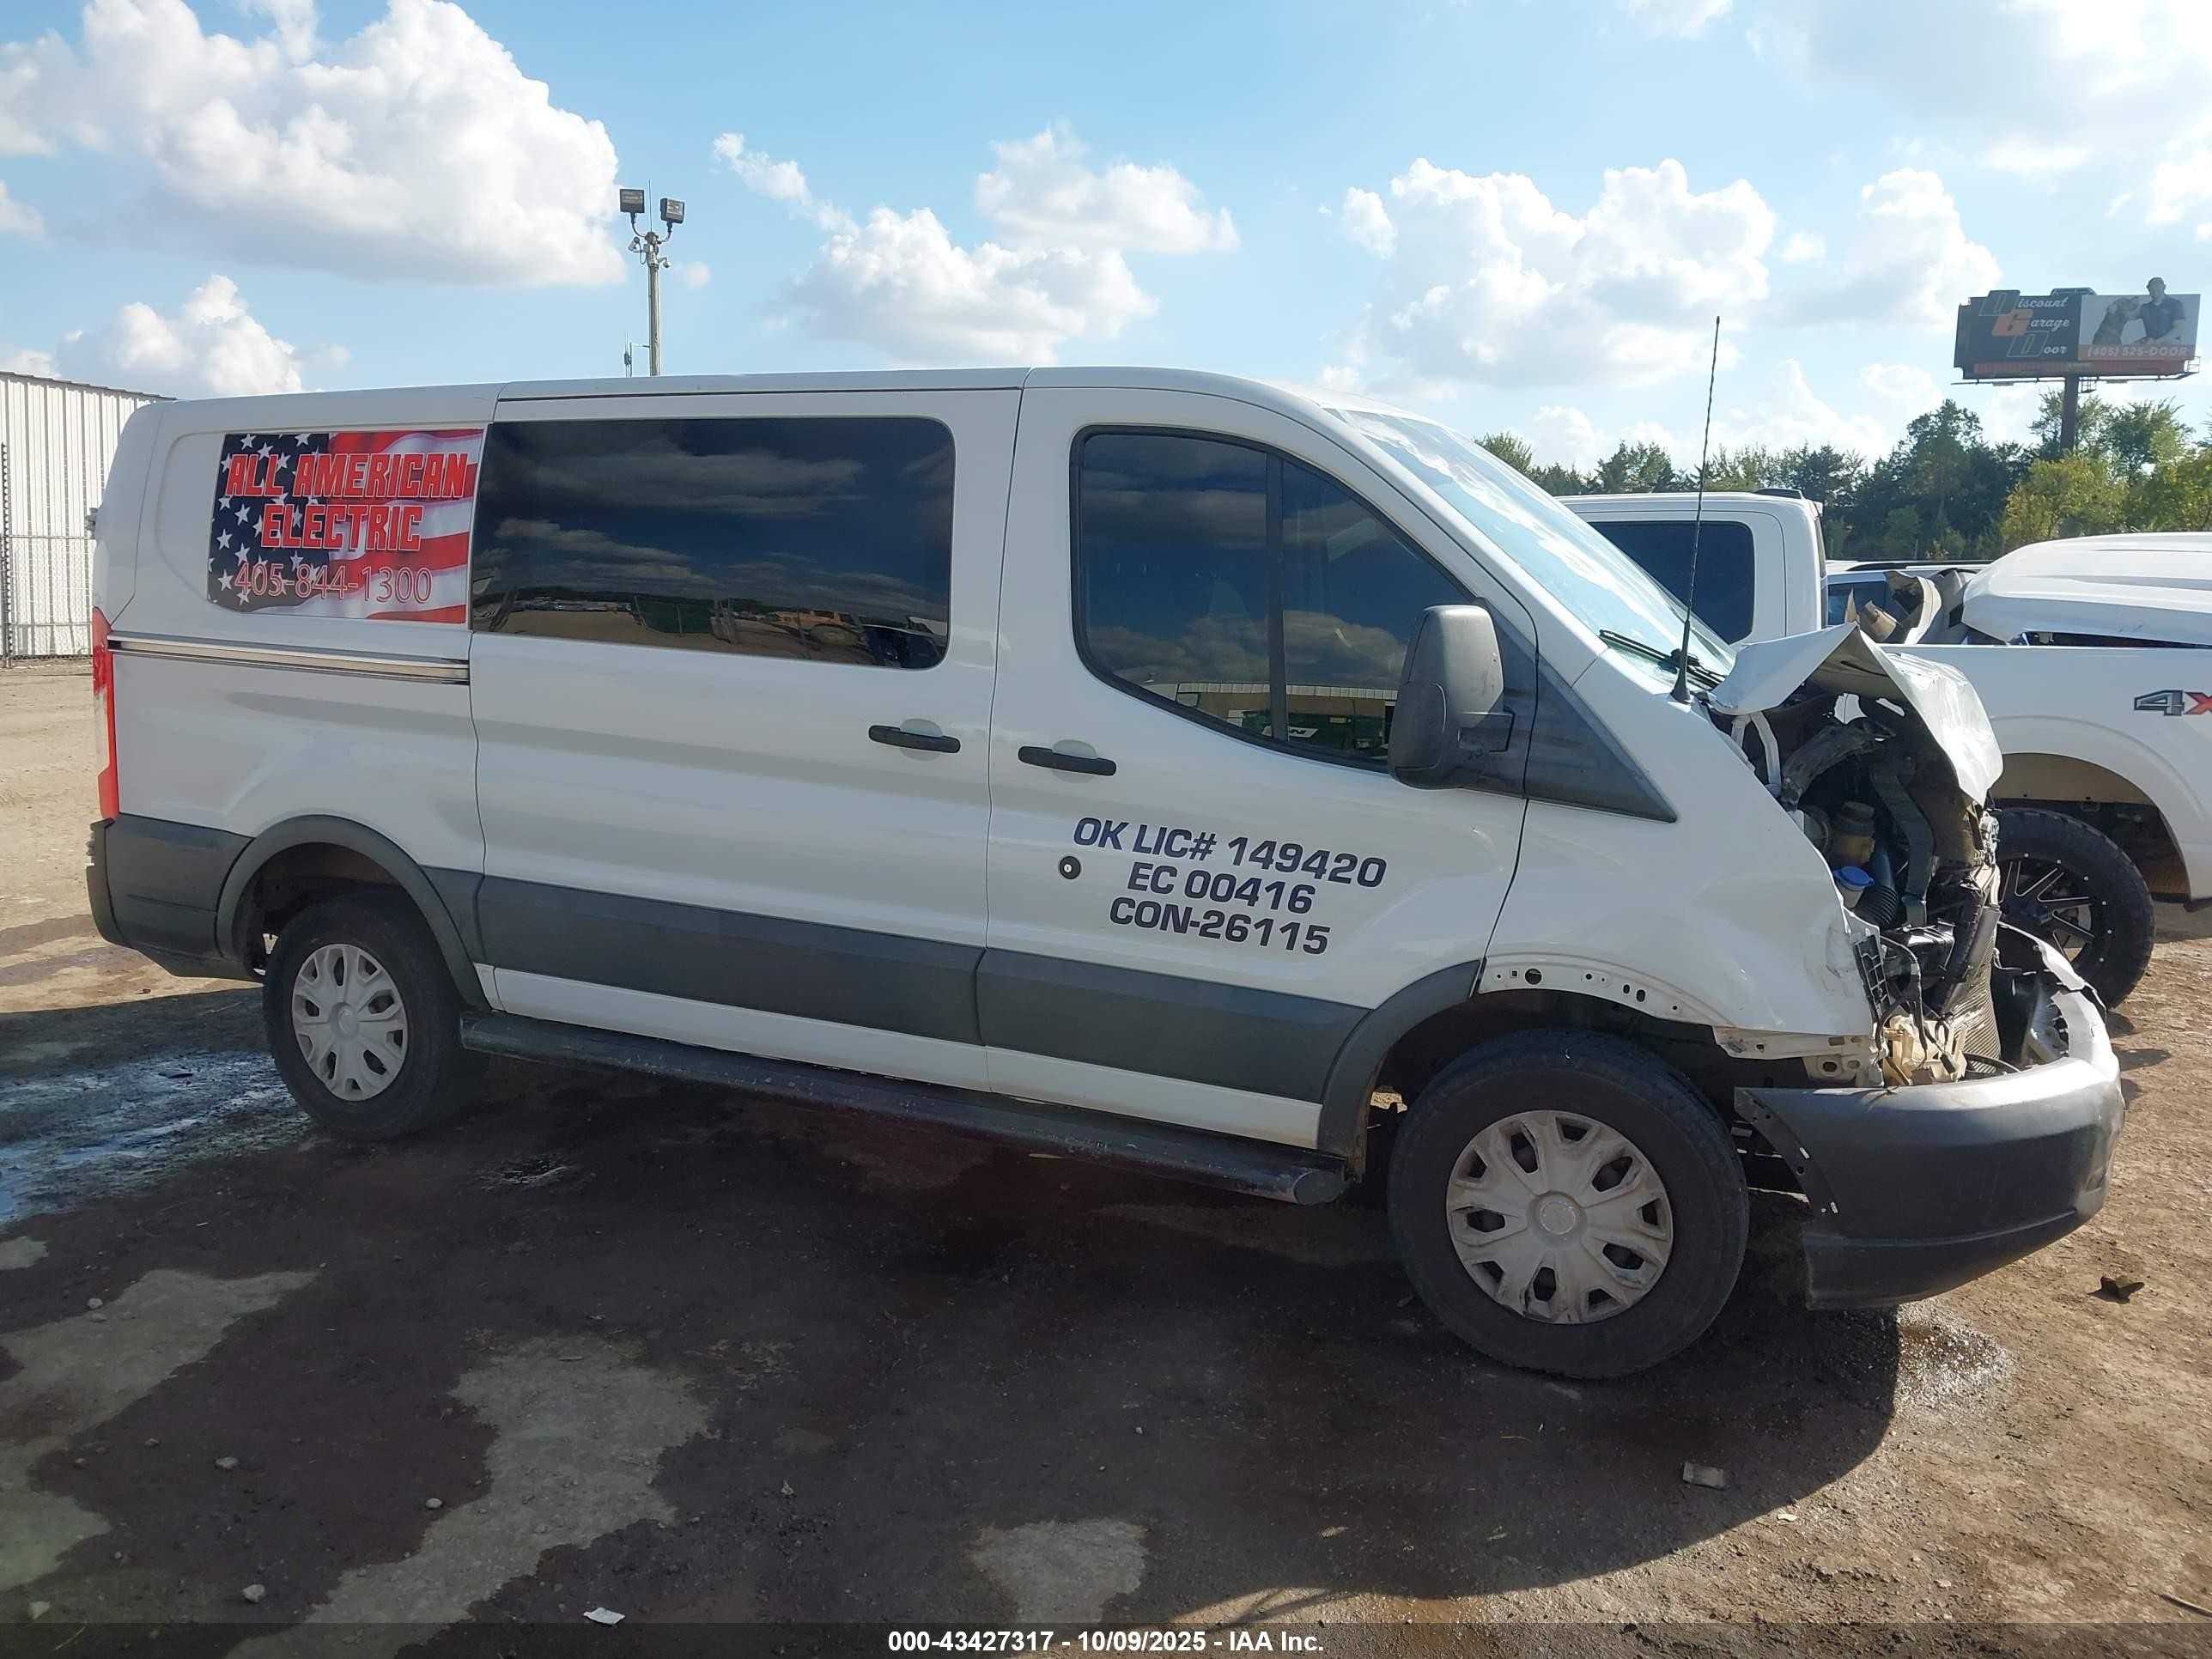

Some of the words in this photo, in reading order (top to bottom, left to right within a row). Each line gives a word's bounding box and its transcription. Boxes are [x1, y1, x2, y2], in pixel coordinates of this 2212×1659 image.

[1978, 290, 2069, 316] Discount
[1991, 308, 2069, 337] Garage
[2006, 330, 2068, 357] Door
[225, 453, 283, 496] ALL
[292, 453, 468, 498] AMERICAN
[260, 504, 424, 551] ELECTRIC
[234, 562, 433, 603] 405-844-1300
[1073, 817, 1129, 850] OK
[1132, 824, 1217, 861] LIC#
[1227, 836, 1387, 888] 149420
[1127, 861, 1178, 895] EC
[1184, 869, 1316, 915] 00416
[1109, 896, 1331, 955] CON-26115
